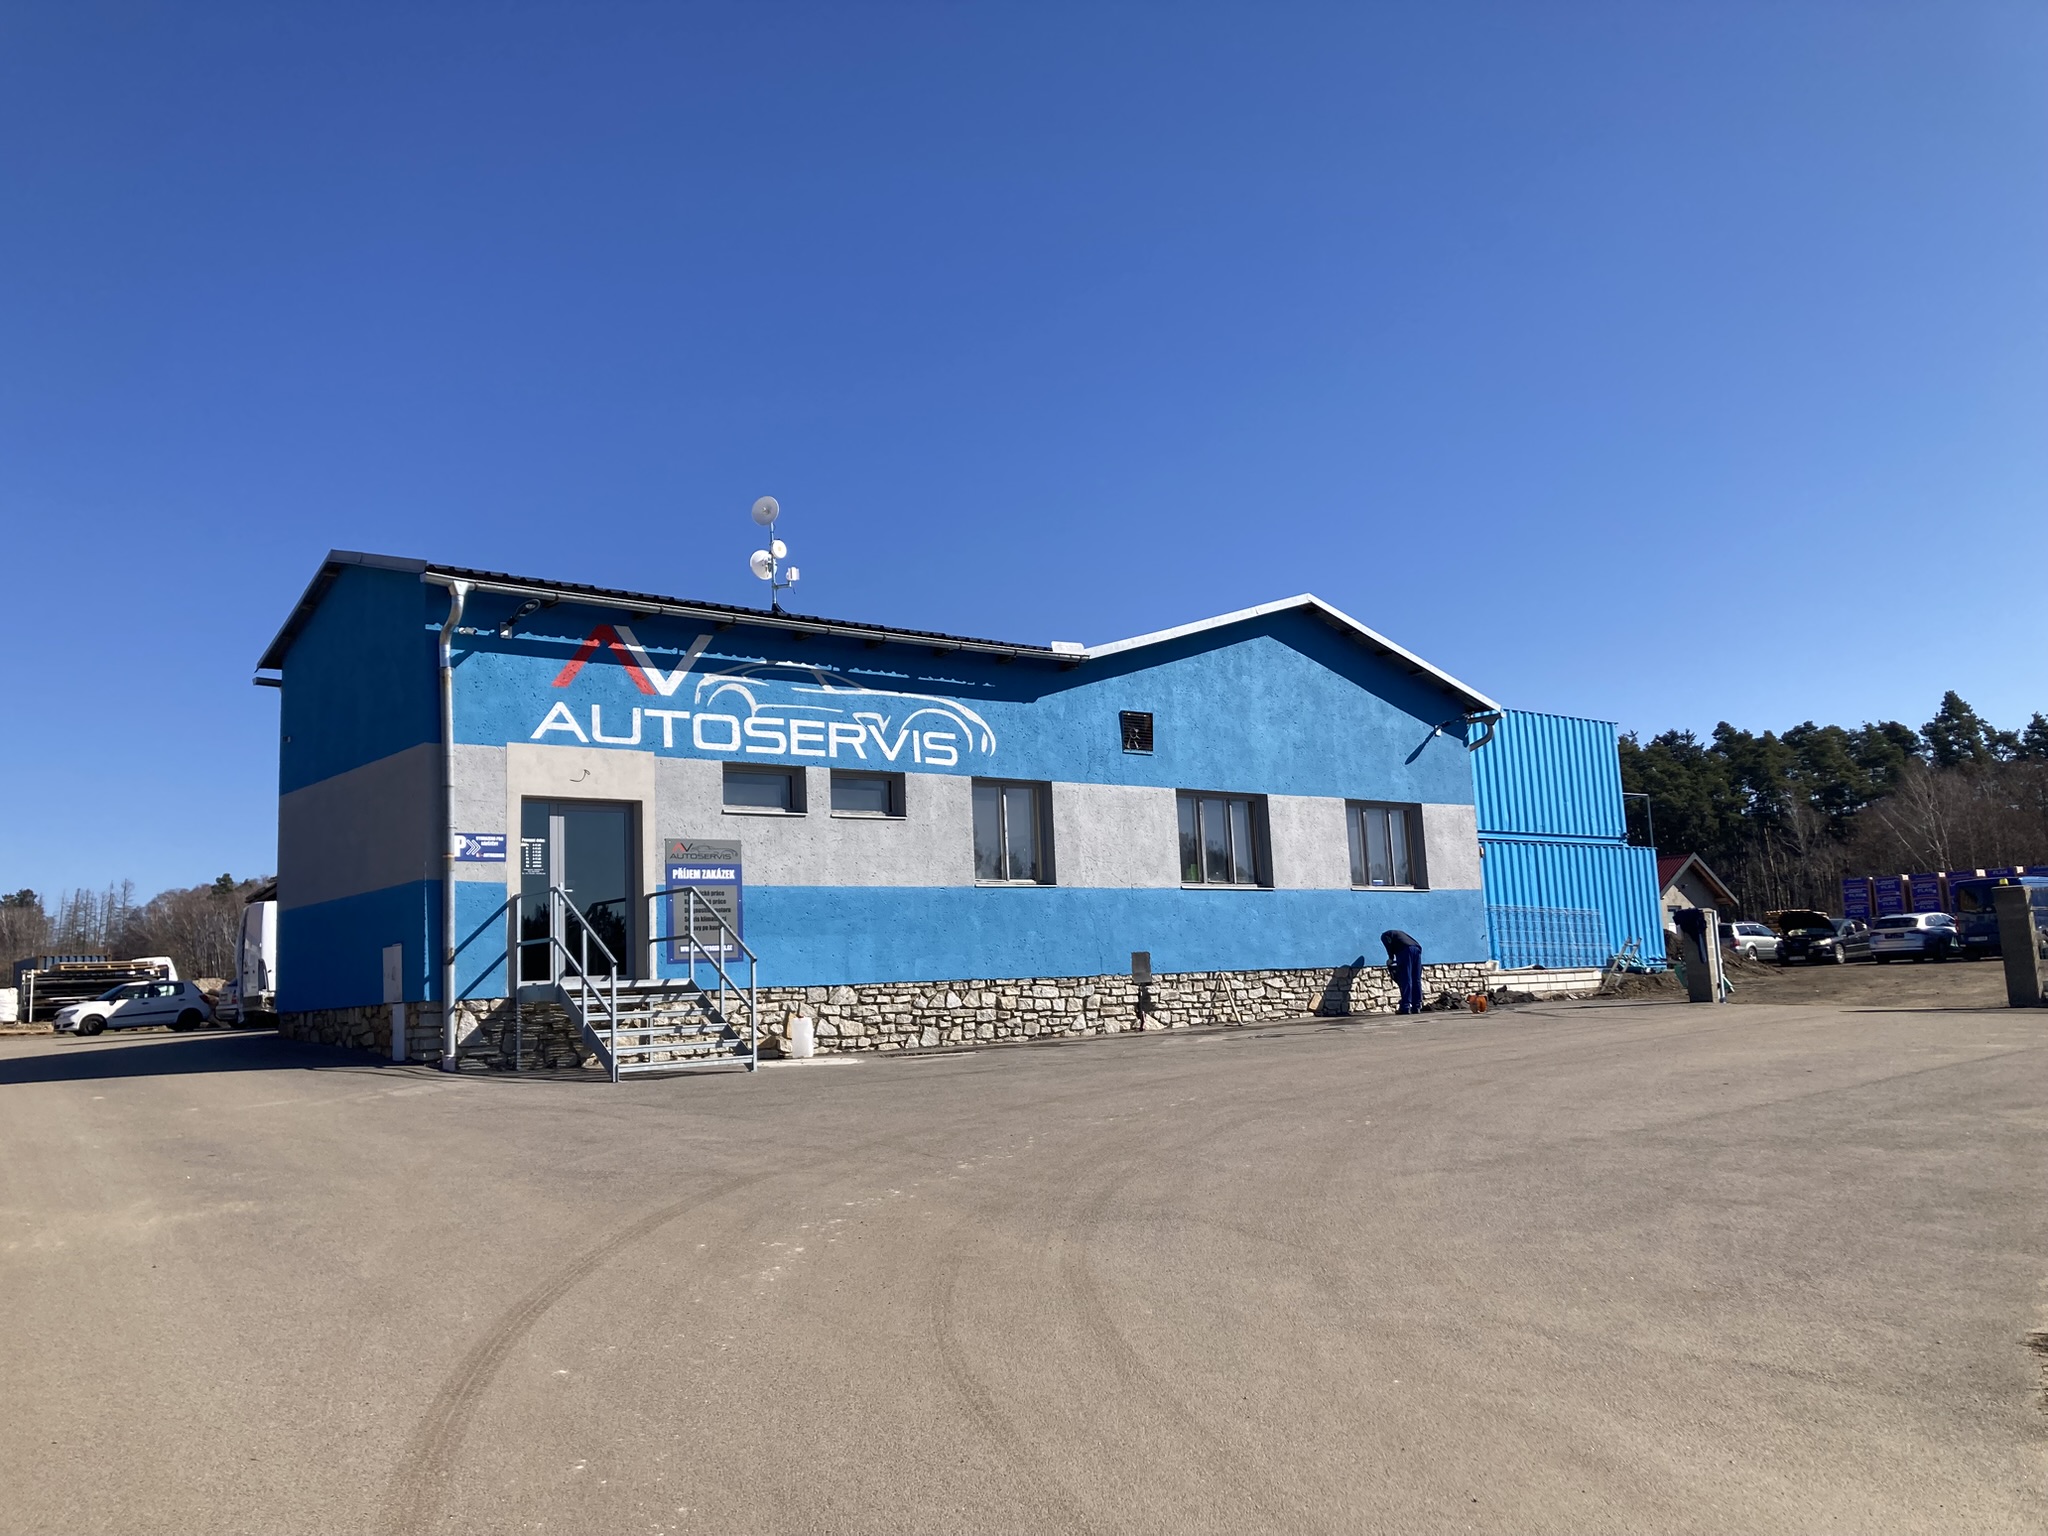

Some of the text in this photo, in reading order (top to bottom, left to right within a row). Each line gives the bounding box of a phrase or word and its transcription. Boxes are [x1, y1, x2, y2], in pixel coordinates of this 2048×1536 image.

[551, 624, 713, 696] AV
[530, 701, 958, 766] AUTOSERVIS
[454, 835, 466, 858] P
[672, 842, 693, 853] AV
[672, 867, 735, 880] PŘÍJEM ZAKÁZEK
